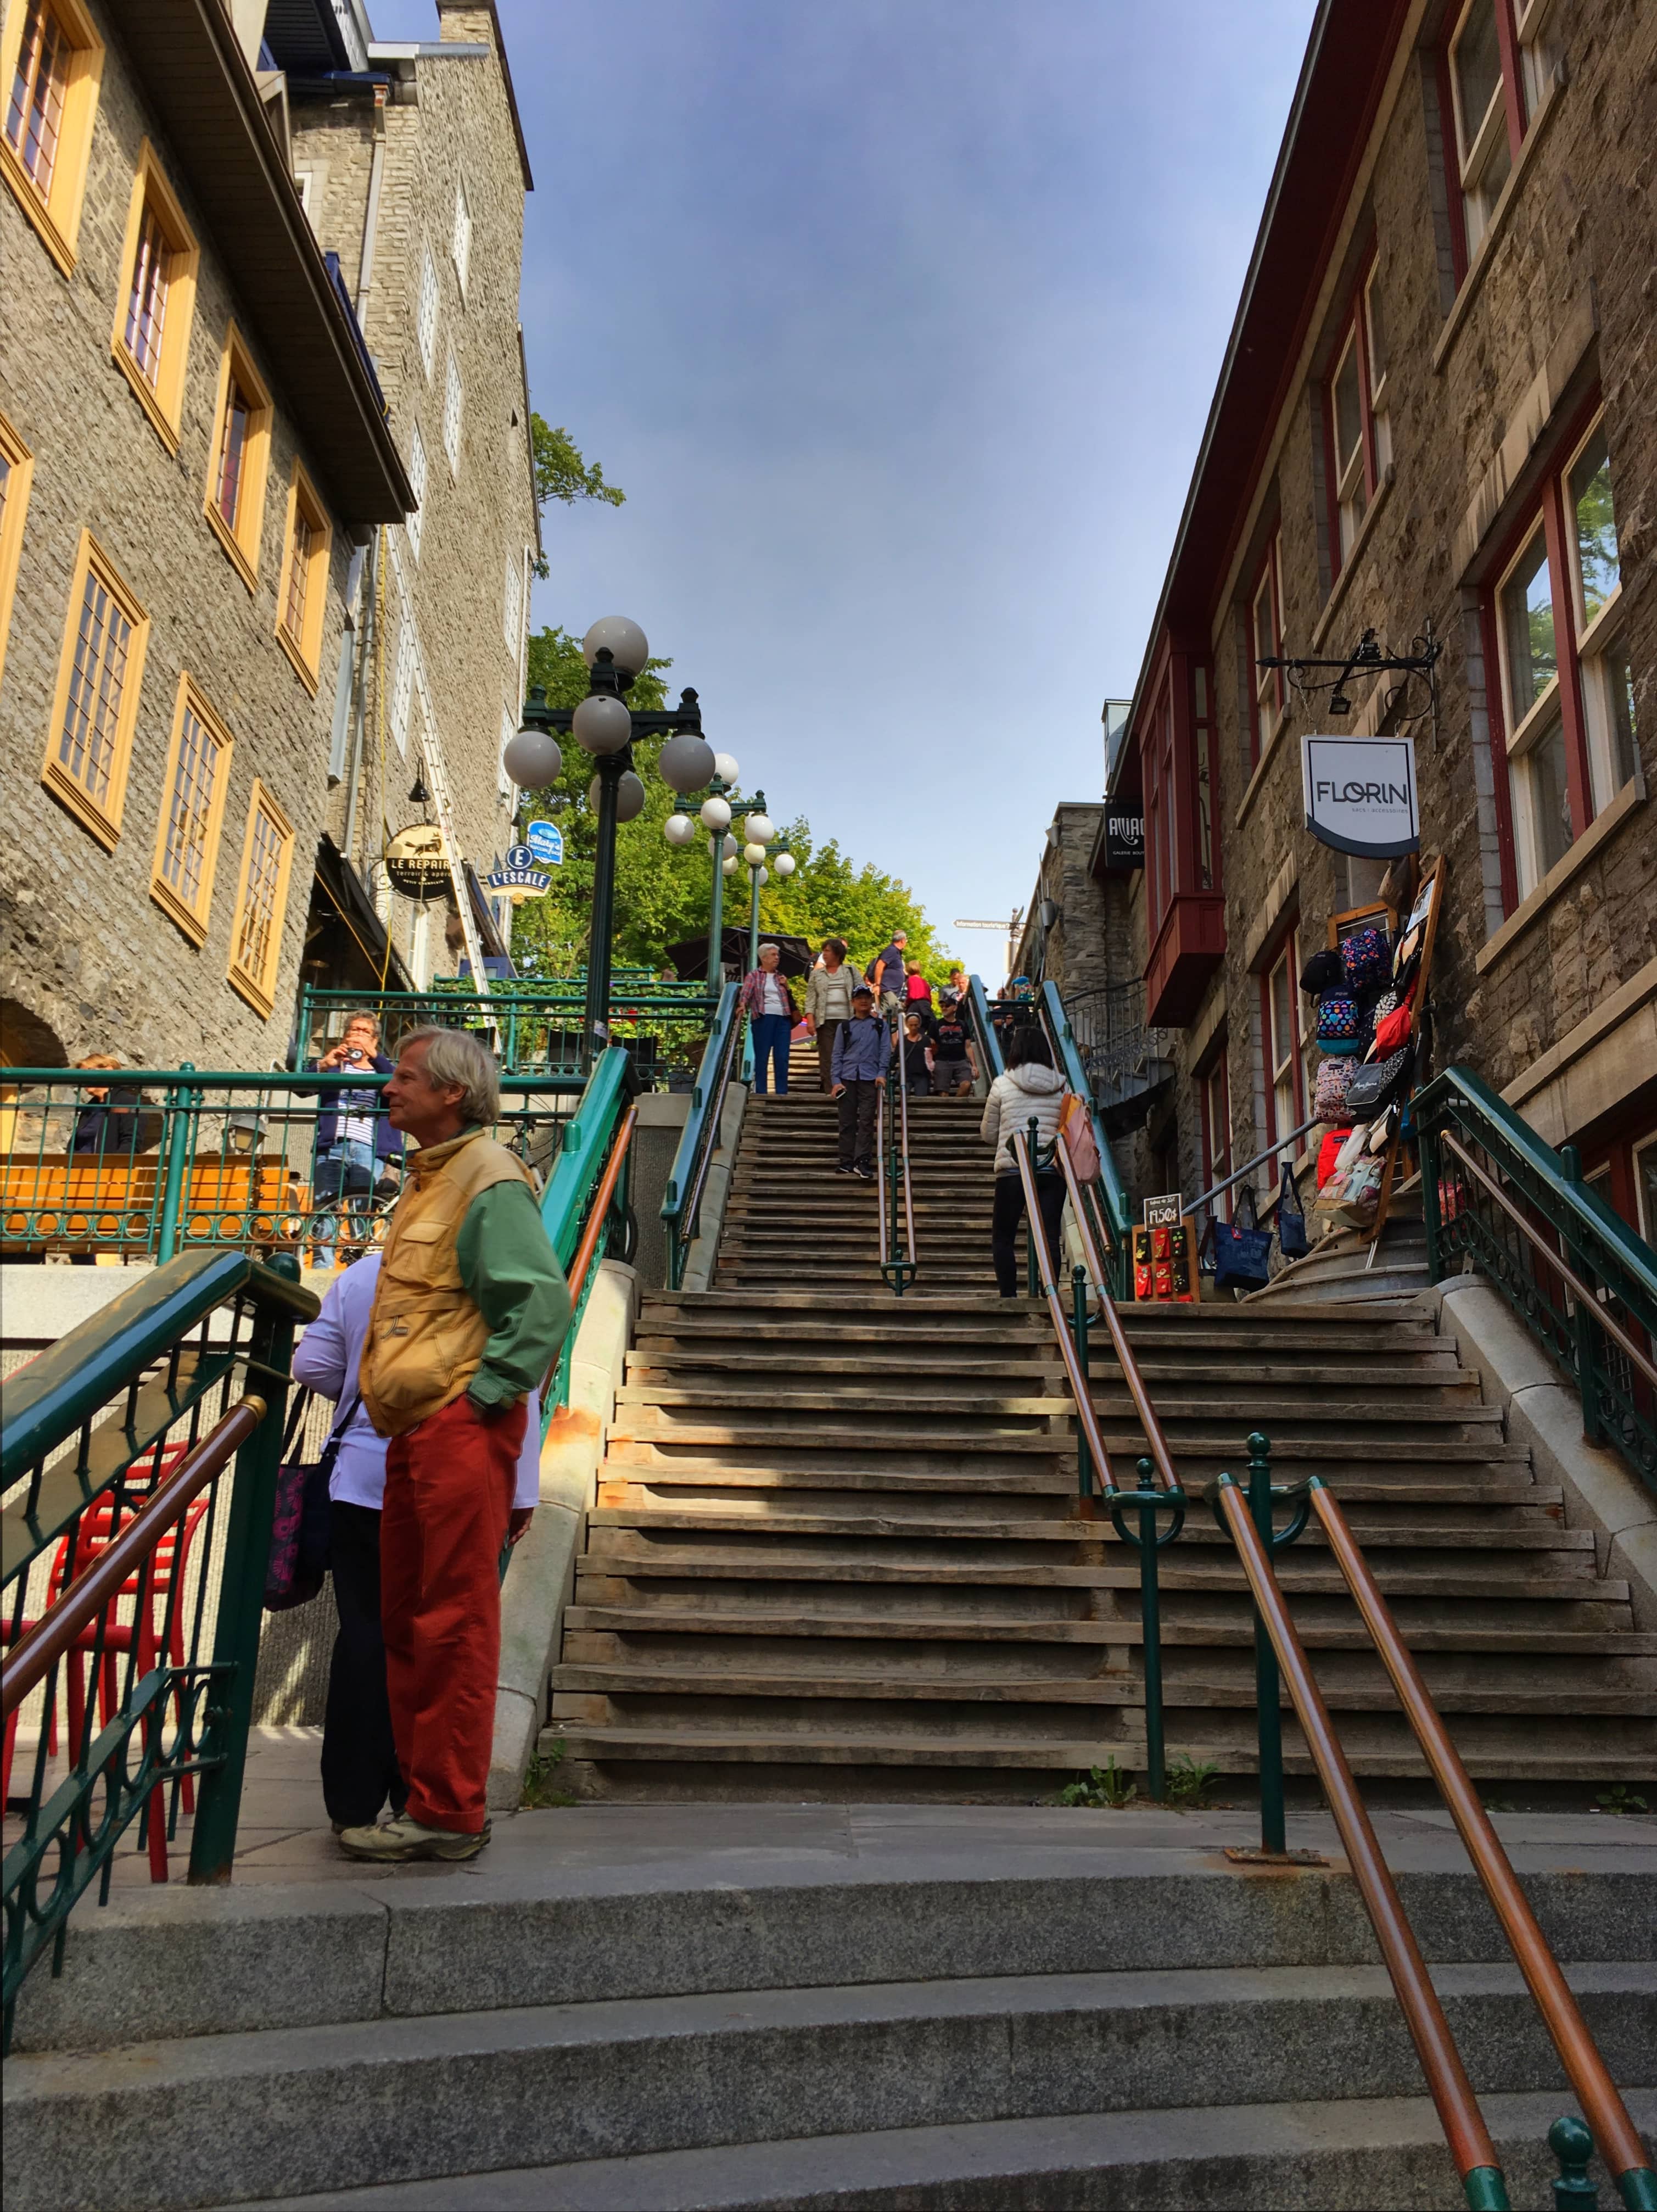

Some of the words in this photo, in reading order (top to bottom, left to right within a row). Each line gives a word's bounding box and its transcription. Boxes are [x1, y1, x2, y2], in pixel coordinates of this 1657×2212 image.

[1317, 781, 1408, 805] FLORIN
[391, 859, 404, 869] LE
[515, 849, 524, 866] E
[492, 871, 546, 887] L'ESCALE
